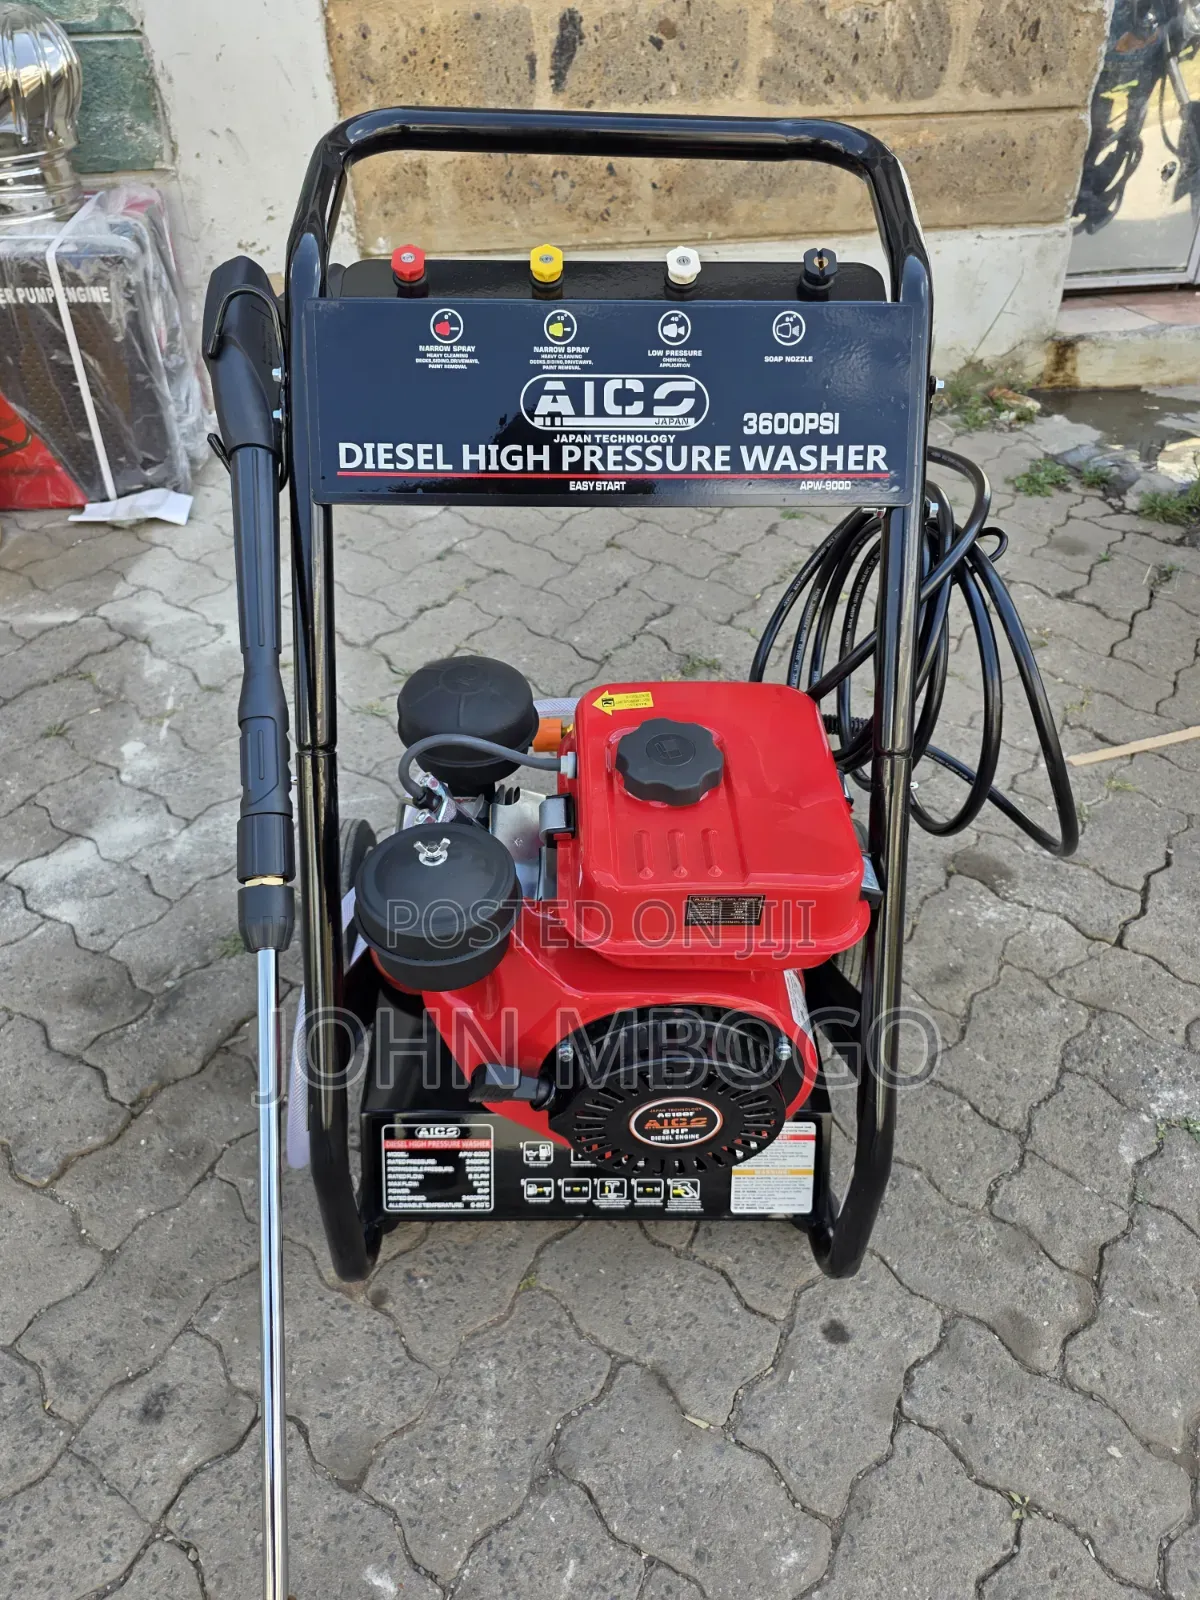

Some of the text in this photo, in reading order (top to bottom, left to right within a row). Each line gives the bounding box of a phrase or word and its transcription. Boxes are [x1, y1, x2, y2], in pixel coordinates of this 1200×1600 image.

[16, 287, 55, 304] PUMP
[63, 286, 111, 303] NGINE
[534, 379, 696, 417] AICS
[654, 417, 690, 426] JAPAN
[743, 412, 840, 435] 3600PSI
[553, 434, 676, 443] JAPAN TECHNOLOGY
[338, 442, 889, 472] DIESEL HIGH PRESSURE WASHER
[569, 481, 626, 491] EASY START
[799, 480, 852, 491] APW-900D
[644, 1117, 708, 1129] AICS
[418, 1127, 459, 1138] AICS
[385, 1140, 491, 1148] DIESEL HIGH PRESSURE WASHER
